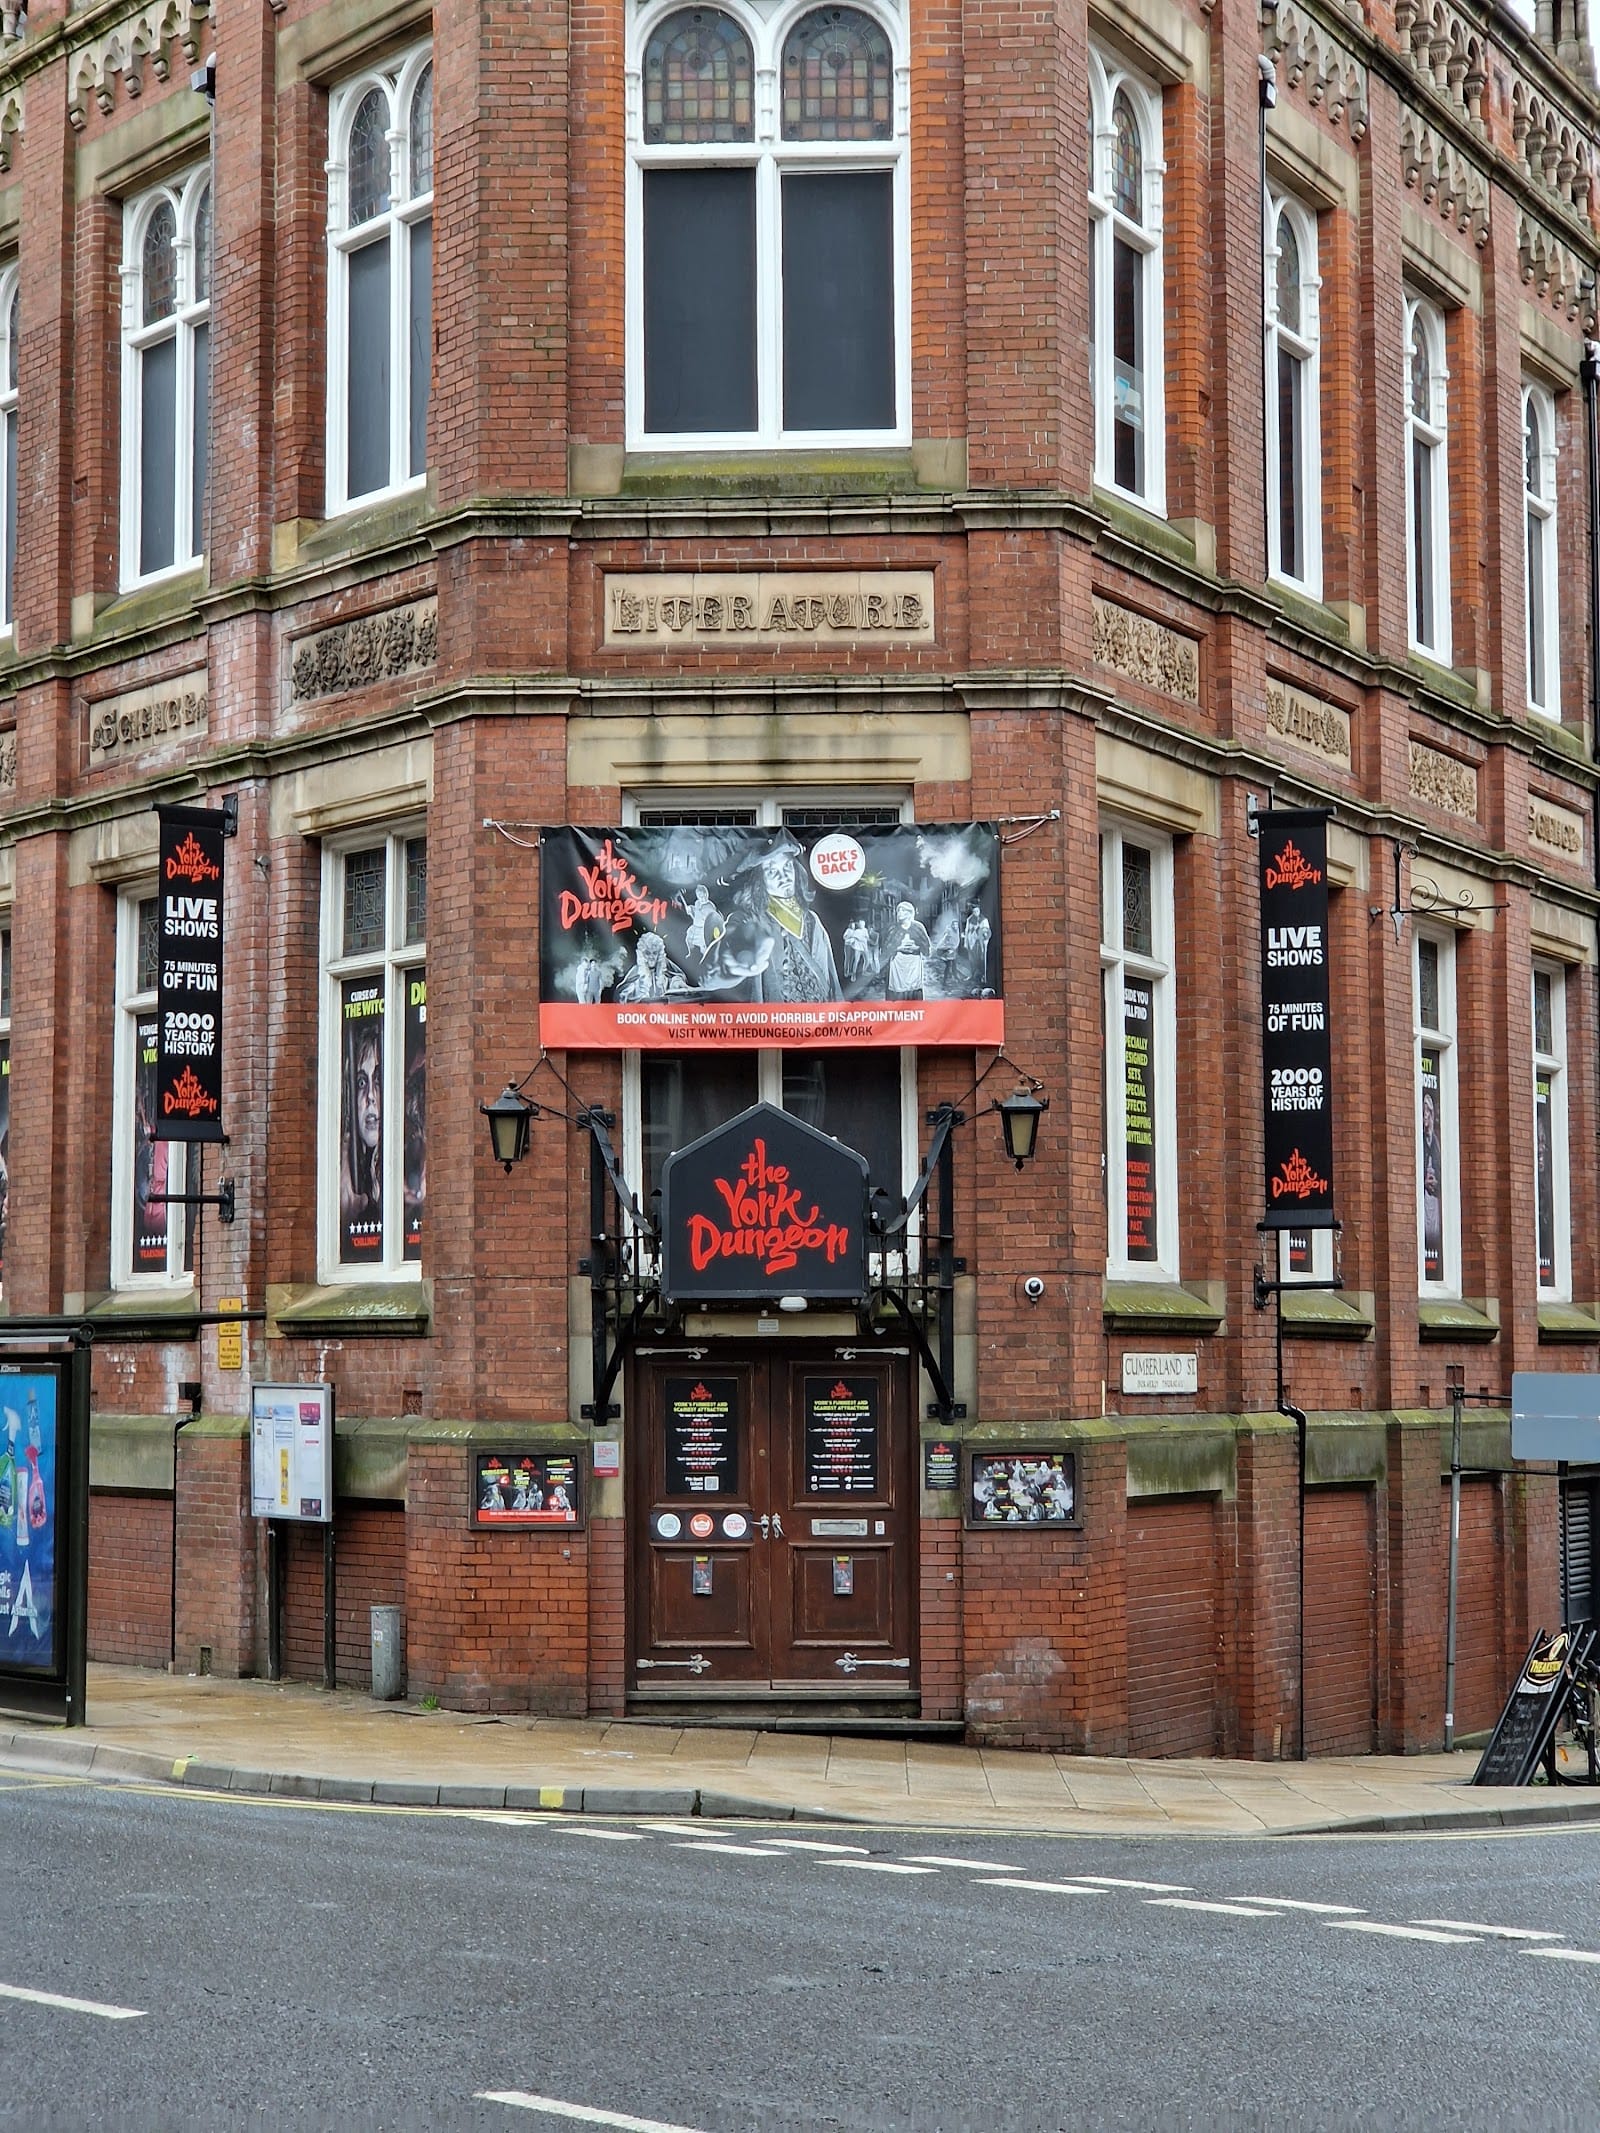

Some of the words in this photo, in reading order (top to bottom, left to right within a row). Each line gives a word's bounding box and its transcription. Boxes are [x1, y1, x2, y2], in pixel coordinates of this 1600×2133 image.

[184, 832, 201, 850] the
[1284, 839, 1301, 858] the
[176, 845, 210, 866] York
[595, 839, 628, 873] the
[817, 849, 858, 865] DICK'S
[1274, 854, 1311, 873] York
[165, 858, 219, 883] Dungeon
[821, 861, 857, 875] BACK
[577, 866, 648, 900] York
[1265, 867, 1321, 890] Dungeon
[166, 896, 217, 921] LIVE
[558, 890, 667, 933] Dungeon
[164, 918, 219, 939] SHOWS
[1268, 926, 1322, 949] LIVE
[164, 960, 176, 971] 75
[177, 961, 217, 974] MINUTES
[1267, 948, 1323, 967] SHOWS
[163, 972, 184, 989] OF
[186, 973, 218, 991] FUN
[350, 989, 369, 1002] CURSE
[370, 988, 378, 999] OF
[344, 1002, 361, 1019] THE
[617, 1012, 647, 1025] BOOK
[649, 1012, 689, 1025] ONLINE
[691, 1012, 716, 1025] NOW
[719, 1013, 733, 1024] TO
[736, 1012, 768, 1024] AVOID
[771, 1012, 825, 1023] HORRIBLE
[828, 1010, 925, 1022] DISAPPOINTMENT
[1268, 1004, 1280, 1015] 75
[1281, 1002, 1323, 1014] MINUTES
[164, 1011, 215, 1031] 2000
[1267, 1014, 1288, 1032] OF
[1291, 1013, 1324, 1031] FUN
[164, 1029, 199, 1042] YEARS
[200, 1031, 215, 1043] OF
[668, 1028, 696, 1039] VISIT
[699, 1026, 873, 1039] WWW.THEDUNGEONS.COM/YORK
[164, 1041, 215, 1056] HISTORY
[181, 1064, 198, 1082] the
[1270, 1067, 1323, 1086] 2000
[173, 1077, 207, 1098] York
[1270, 1085, 1306, 1098] YEARS
[1309, 1085, 1323, 1097] OF
[164, 1091, 217, 1116] Dungeon
[1271, 1096, 1323, 1111] HISTORY
[741, 1138, 790, 1189] the
[1289, 1147, 1307, 1166] the
[1281, 1163, 1317, 1181] York
[1271, 1176, 1328, 1198] Dungeon
[714, 1178, 819, 1229] York
[687, 1214, 848, 1276] Dungeon
[1125, 1358, 1182, 1376] CUMBERLAND
